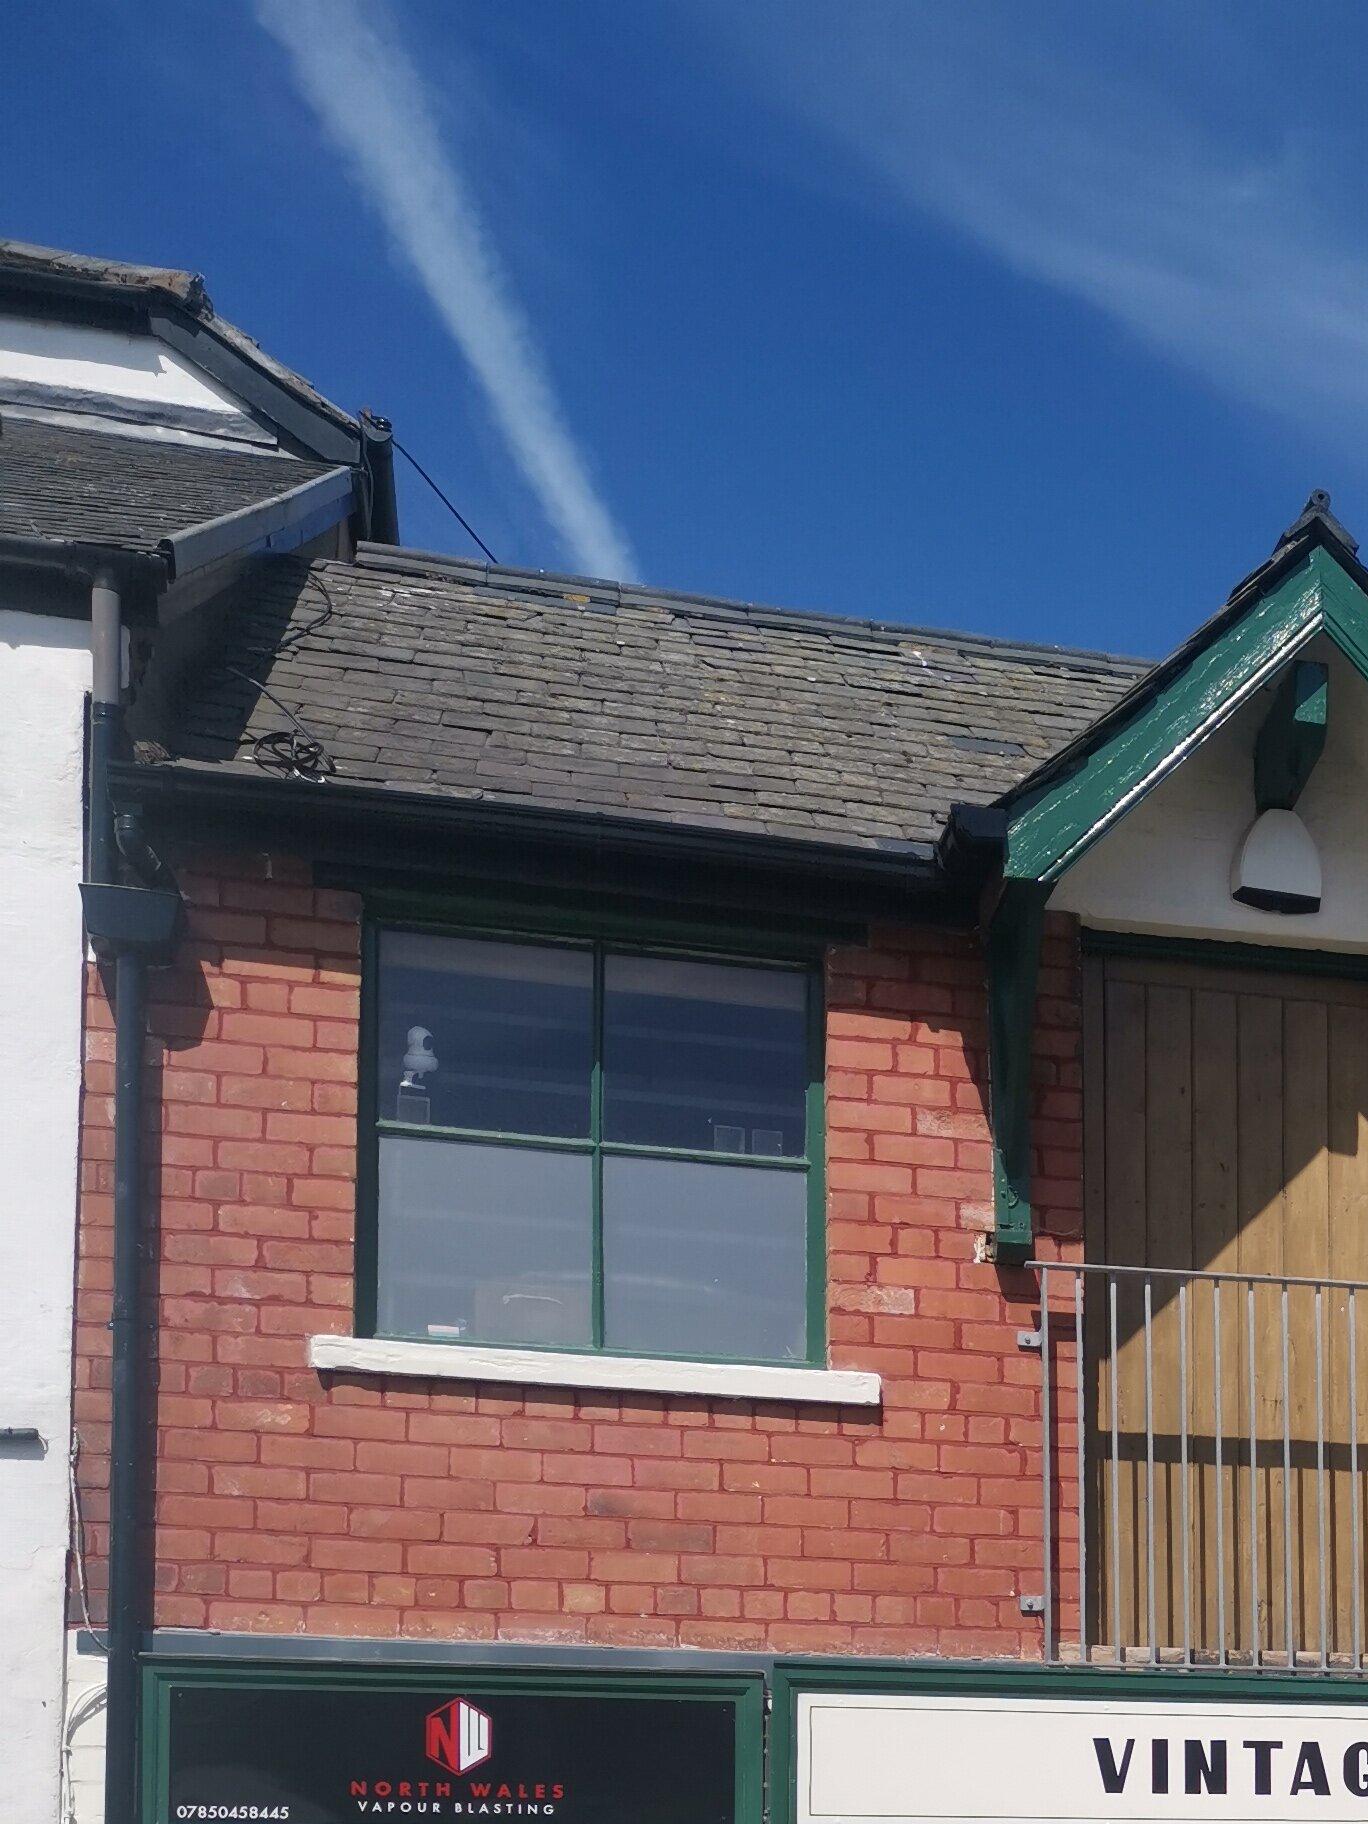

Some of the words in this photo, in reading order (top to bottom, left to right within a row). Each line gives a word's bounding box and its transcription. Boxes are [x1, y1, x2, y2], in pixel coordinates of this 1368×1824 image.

[349, 1780, 451, 1798] NORTH
[470, 1782, 565, 1799] WALES
[175, 1805, 290, 1821] 07850458445
[357, 1800, 441, 1814] VAPOUR
[454, 1802, 555, 1816] BLASTING
